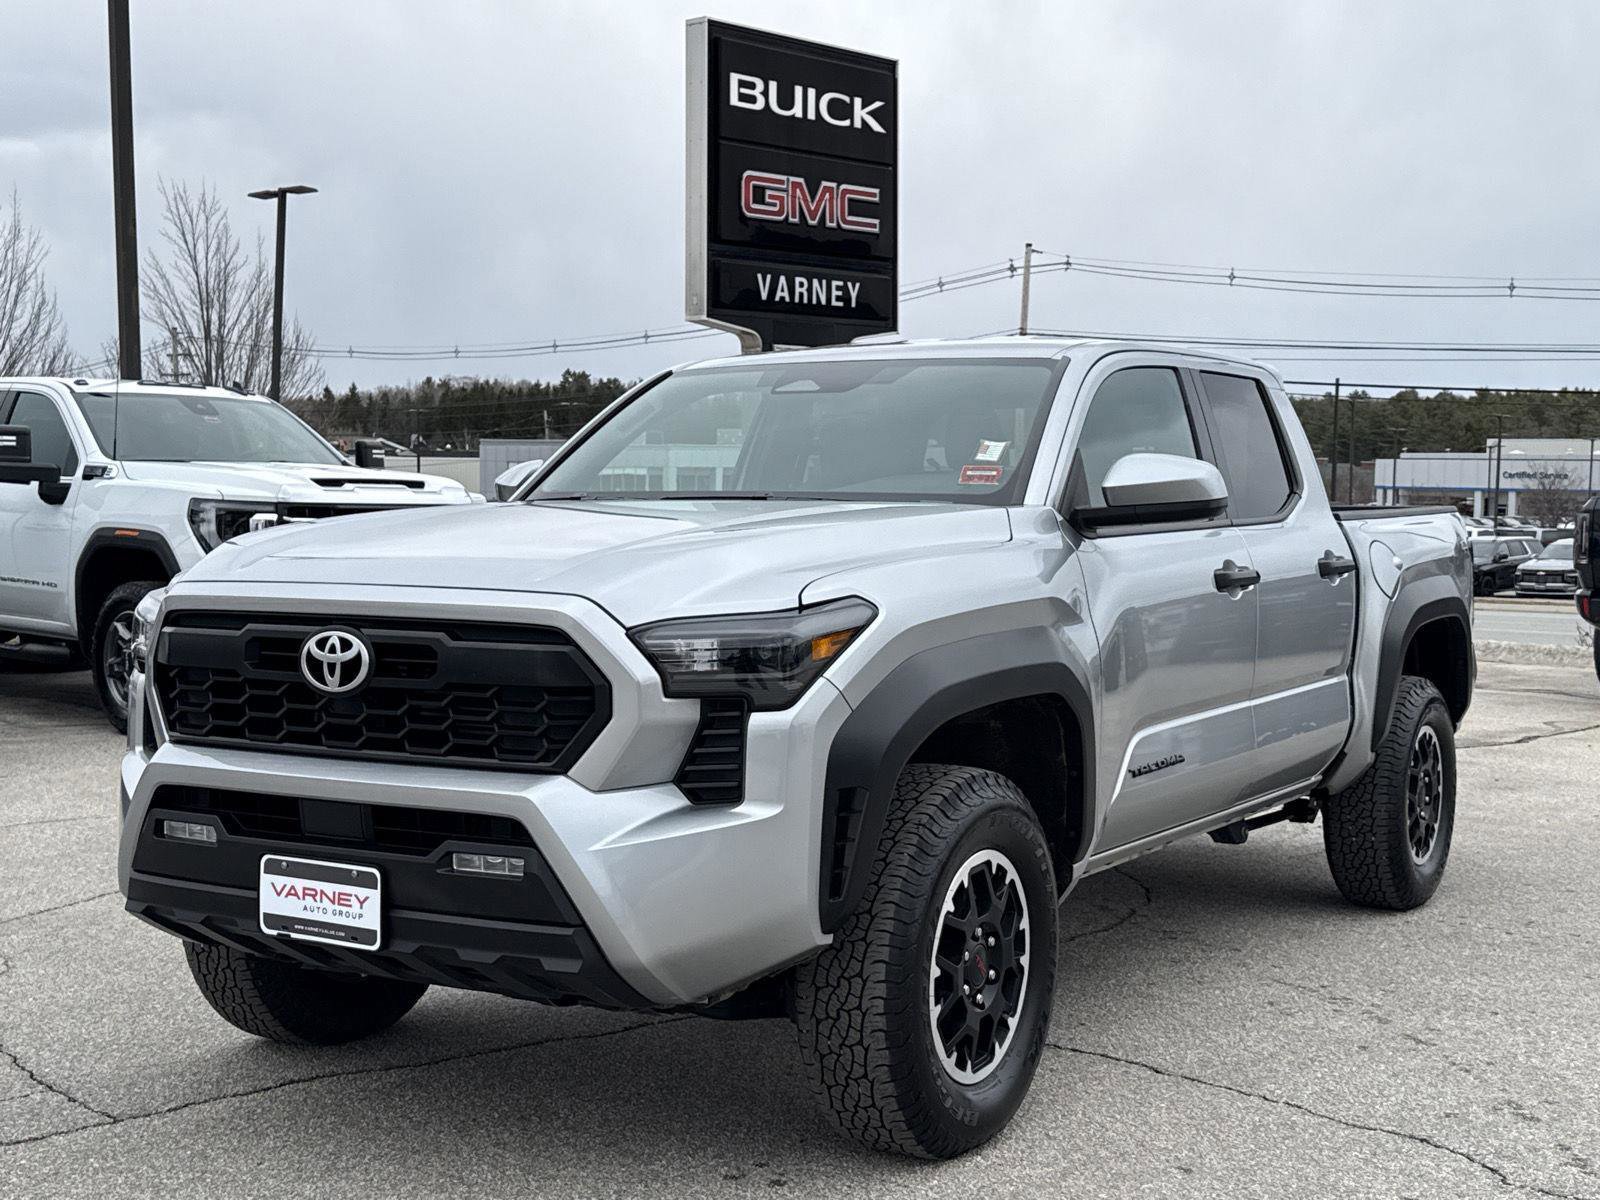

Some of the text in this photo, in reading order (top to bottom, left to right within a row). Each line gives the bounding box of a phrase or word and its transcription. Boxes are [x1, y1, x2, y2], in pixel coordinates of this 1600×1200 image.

[729, 72, 887, 133] BUICK
[741, 169, 880, 232] GMC
[756, 272, 861, 308] VARNEY
[1502, 471, 1569, 480] Certified Service
[1128, 754, 1186, 778] TACOMA
[271, 881, 370, 909] VARNEY
[302, 904, 364, 921] AUTO GROUP
